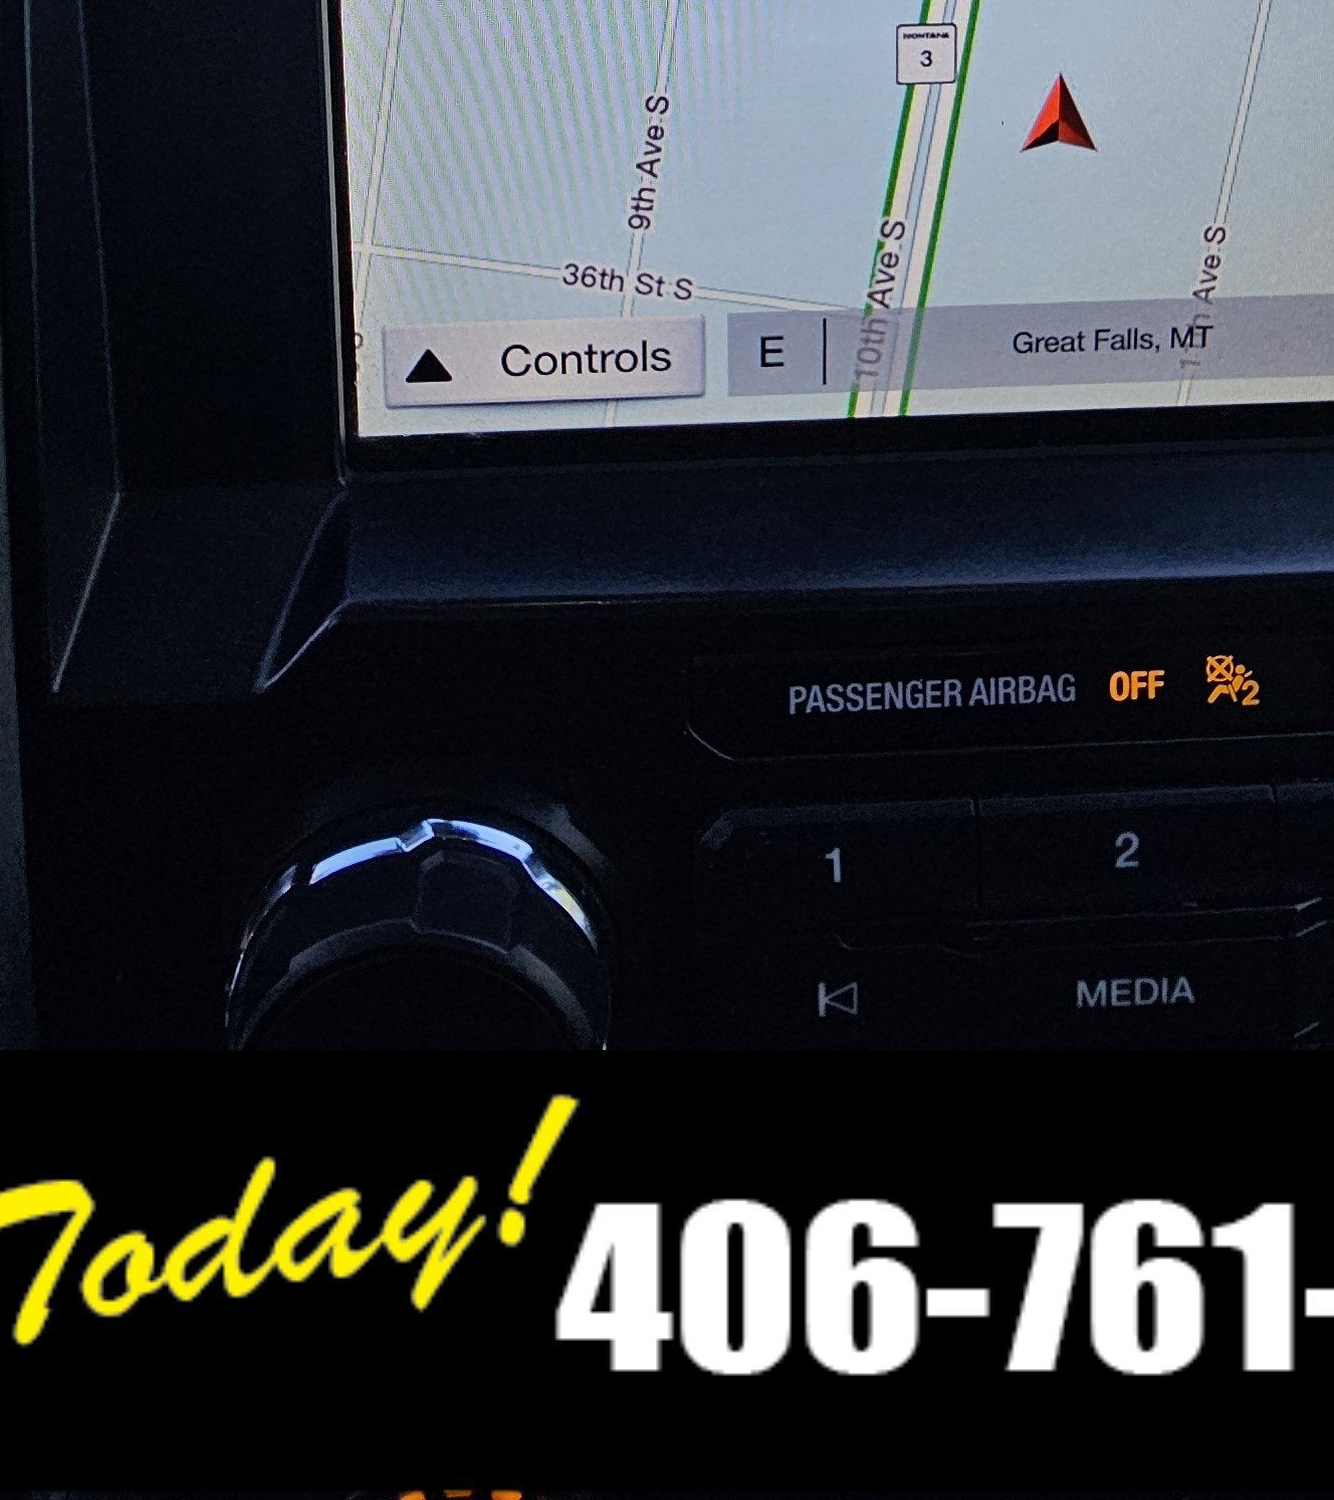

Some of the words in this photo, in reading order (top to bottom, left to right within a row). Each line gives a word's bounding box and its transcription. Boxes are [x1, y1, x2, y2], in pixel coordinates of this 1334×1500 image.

[919, 49, 933, 68] 3
[646, 95, 670, 114] S
[635, 125, 665, 179] Ave
[627, 187, 656, 230] 9th
[880, 218, 906, 241] S
[1204, 225, 1226, 245] S
[562, 263, 624, 292] 36th
[634, 272, 665, 298] St
[673, 277, 694, 301] S
[866, 251, 900, 309] Ave
[1192, 253, 1222, 306] Ave
[501, 339, 672, 377] Controls
[760, 335, 785, 368] E
[854, 318, 888, 382] 10th
[1013, 330, 1086, 354] Great
[1094, 327, 1160, 353] Falls,
[1170, 325, 1214, 349] MT
[789, 678, 963, 715] PASSENGER
[969, 673, 1076, 706] AIRBAG
[1109, 670, 1165, 701] OFF
[825, 847, 842, 883] 1
[1115, 831, 1140, 869] 2
[1076, 976, 1196, 1009] MEDIA
